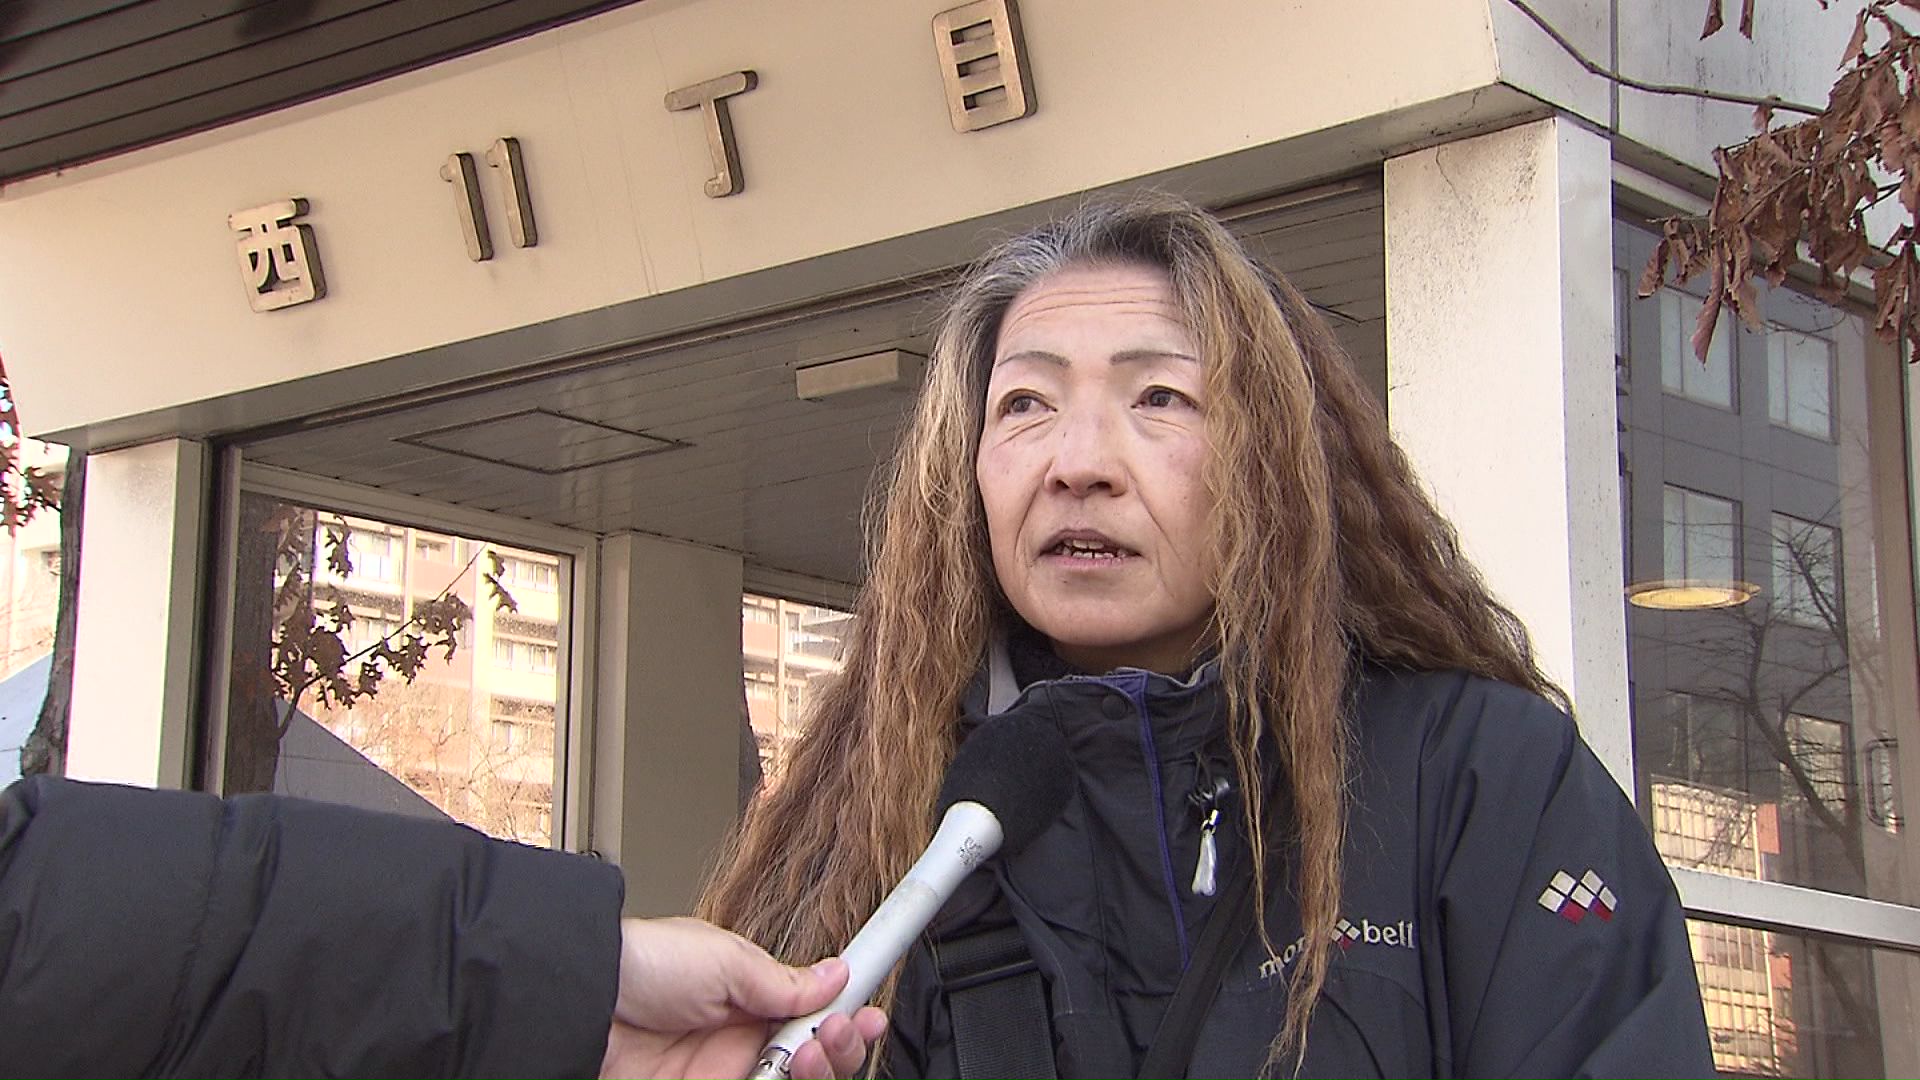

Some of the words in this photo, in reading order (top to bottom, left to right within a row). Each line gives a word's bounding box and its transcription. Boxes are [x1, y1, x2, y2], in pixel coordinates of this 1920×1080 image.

[228, 0, 1037, 313] 西11丁目
[1361, 918, 1415, 949] bell
